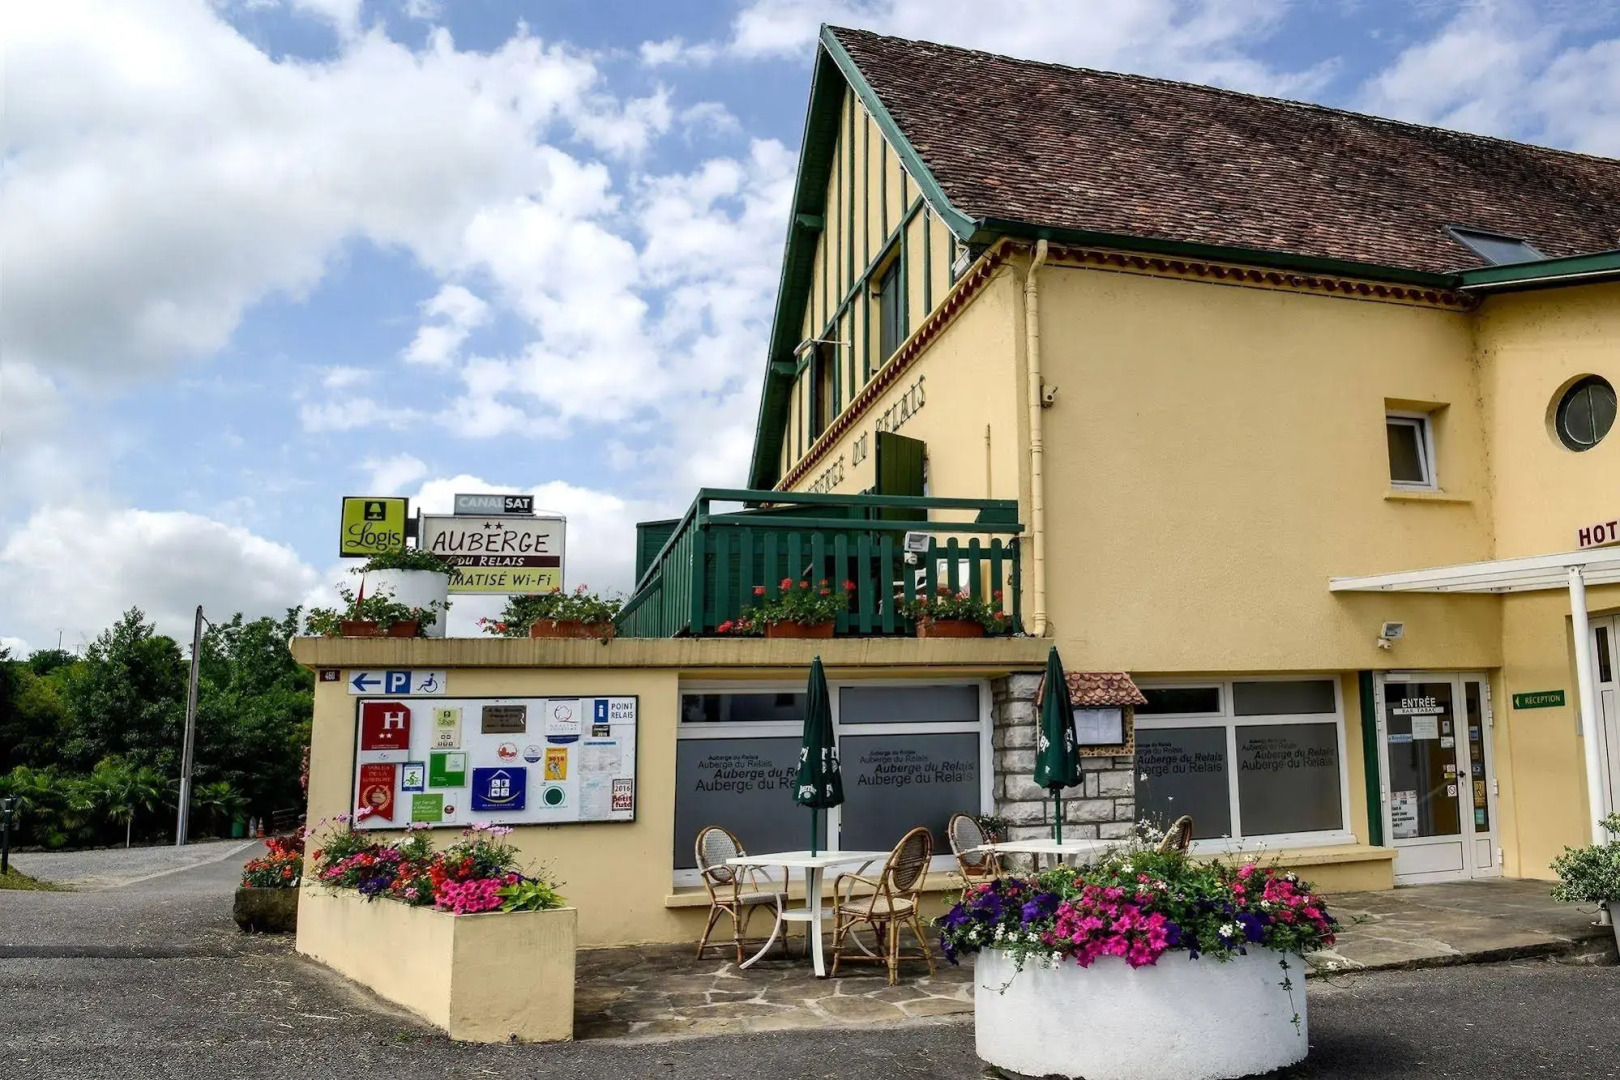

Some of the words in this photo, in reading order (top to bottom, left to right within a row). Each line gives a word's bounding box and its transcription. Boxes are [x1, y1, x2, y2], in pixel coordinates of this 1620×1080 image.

[345, 521, 401, 551] Logis
[432, 530, 550, 553] AUBERGE
[457, 556, 474, 566] DU
[479, 555, 525, 567] RELAIS
[447, 571, 508, 586] IMATISÉ
[512, 573, 552, 586] Wi-Fi
[391, 672, 406, 693] P
[611, 702, 634, 710] POINT
[1401, 695, 1437, 708] ENTRÉE
[382, 711, 407, 730] H
[610, 711, 634, 719] RELAIS
[860, 756, 892, 764] Auberge
[1137, 755, 1178, 766] Auberge
[1180, 754, 1192, 763] du
[1195, 752, 1224, 762] Relais
[1254, 751, 1292, 760] Auberge
[1294, 749, 1305, 758] du
[698, 761, 733, 769] Auberge
[874, 763, 921, 775] Auberge
[924, 763, 938, 772] du
[941, 761, 974, 771] Relais
[1172, 764, 1186, 774] du
[1189, 762, 1222, 773] Relais
[1241, 760, 1284, 772] Auberge
[1286, 759, 1300, 768] du
[1303, 757, 1334, 767] Relais
[713, 768, 765, 780] Auberge
[767, 768, 783, 778] du
[857, 774, 912, 787] Auberge
[915, 773, 931, 783] du
[935, 771, 974, 783] Relais
[695, 778, 753, 793] Auberge
[757, 778, 774, 790] du
